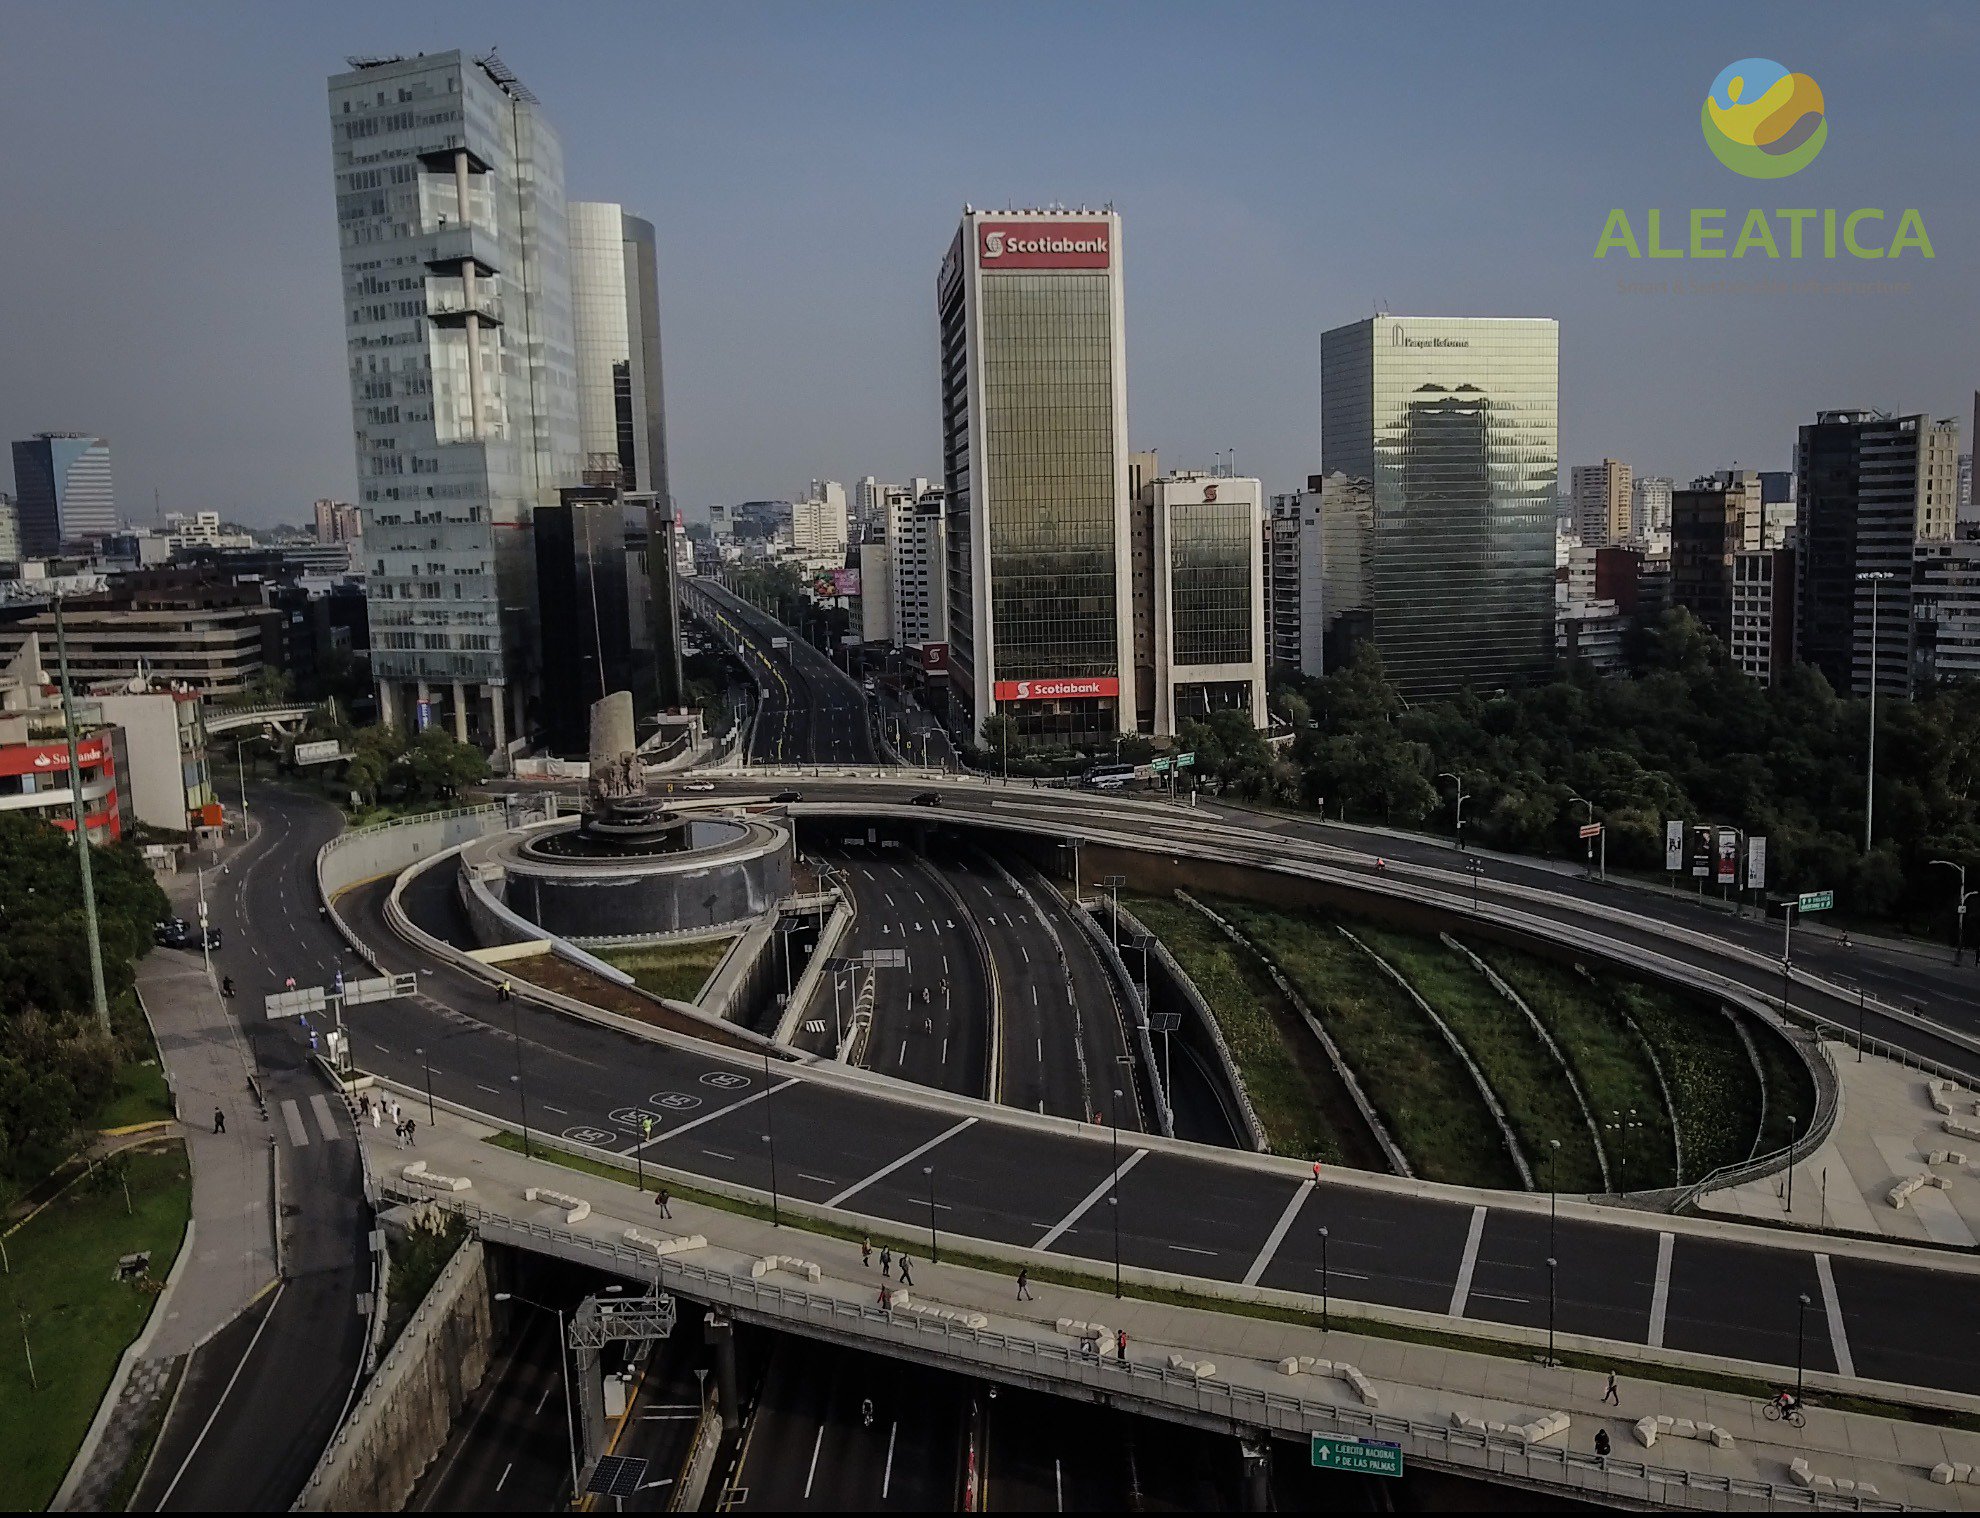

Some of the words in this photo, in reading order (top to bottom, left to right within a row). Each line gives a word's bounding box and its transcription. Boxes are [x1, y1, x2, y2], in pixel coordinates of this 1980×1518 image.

[1006, 237, 1108, 253] Scotiabank
[1034, 682, 1100, 695] Scotiabank
[1366, 1447, 1395, 1459] NACIONAL
[1342, 1457, 1352, 1466] DE
[1354, 1458, 1367, 1467] LAS
[1369, 1460, 1396, 1471] PALMAS
